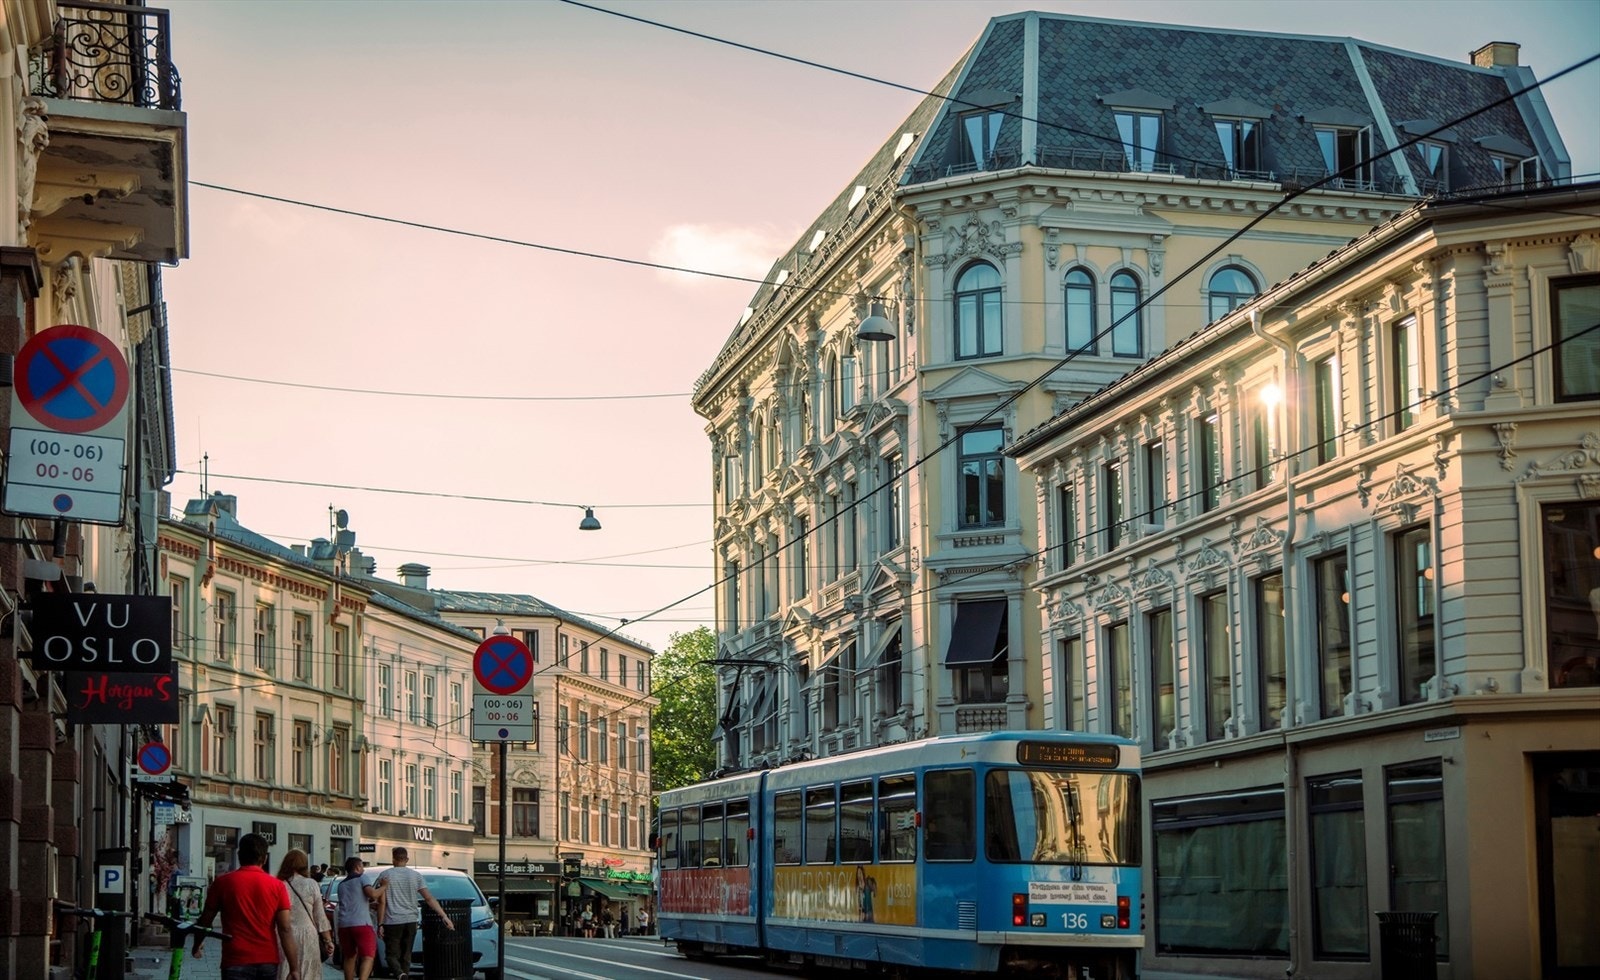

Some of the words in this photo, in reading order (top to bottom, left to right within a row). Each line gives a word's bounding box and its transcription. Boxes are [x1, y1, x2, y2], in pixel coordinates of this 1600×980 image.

[73, 602, 130, 629] VU
[44, 635, 160, 664] OSLO
[330, 824, 353, 837] GANNI
[413, 826, 433, 841] VOLT
[527, 863, 545, 874] Pub
[104, 869, 120, 888] P
[1061, 913, 1088, 930] 136
